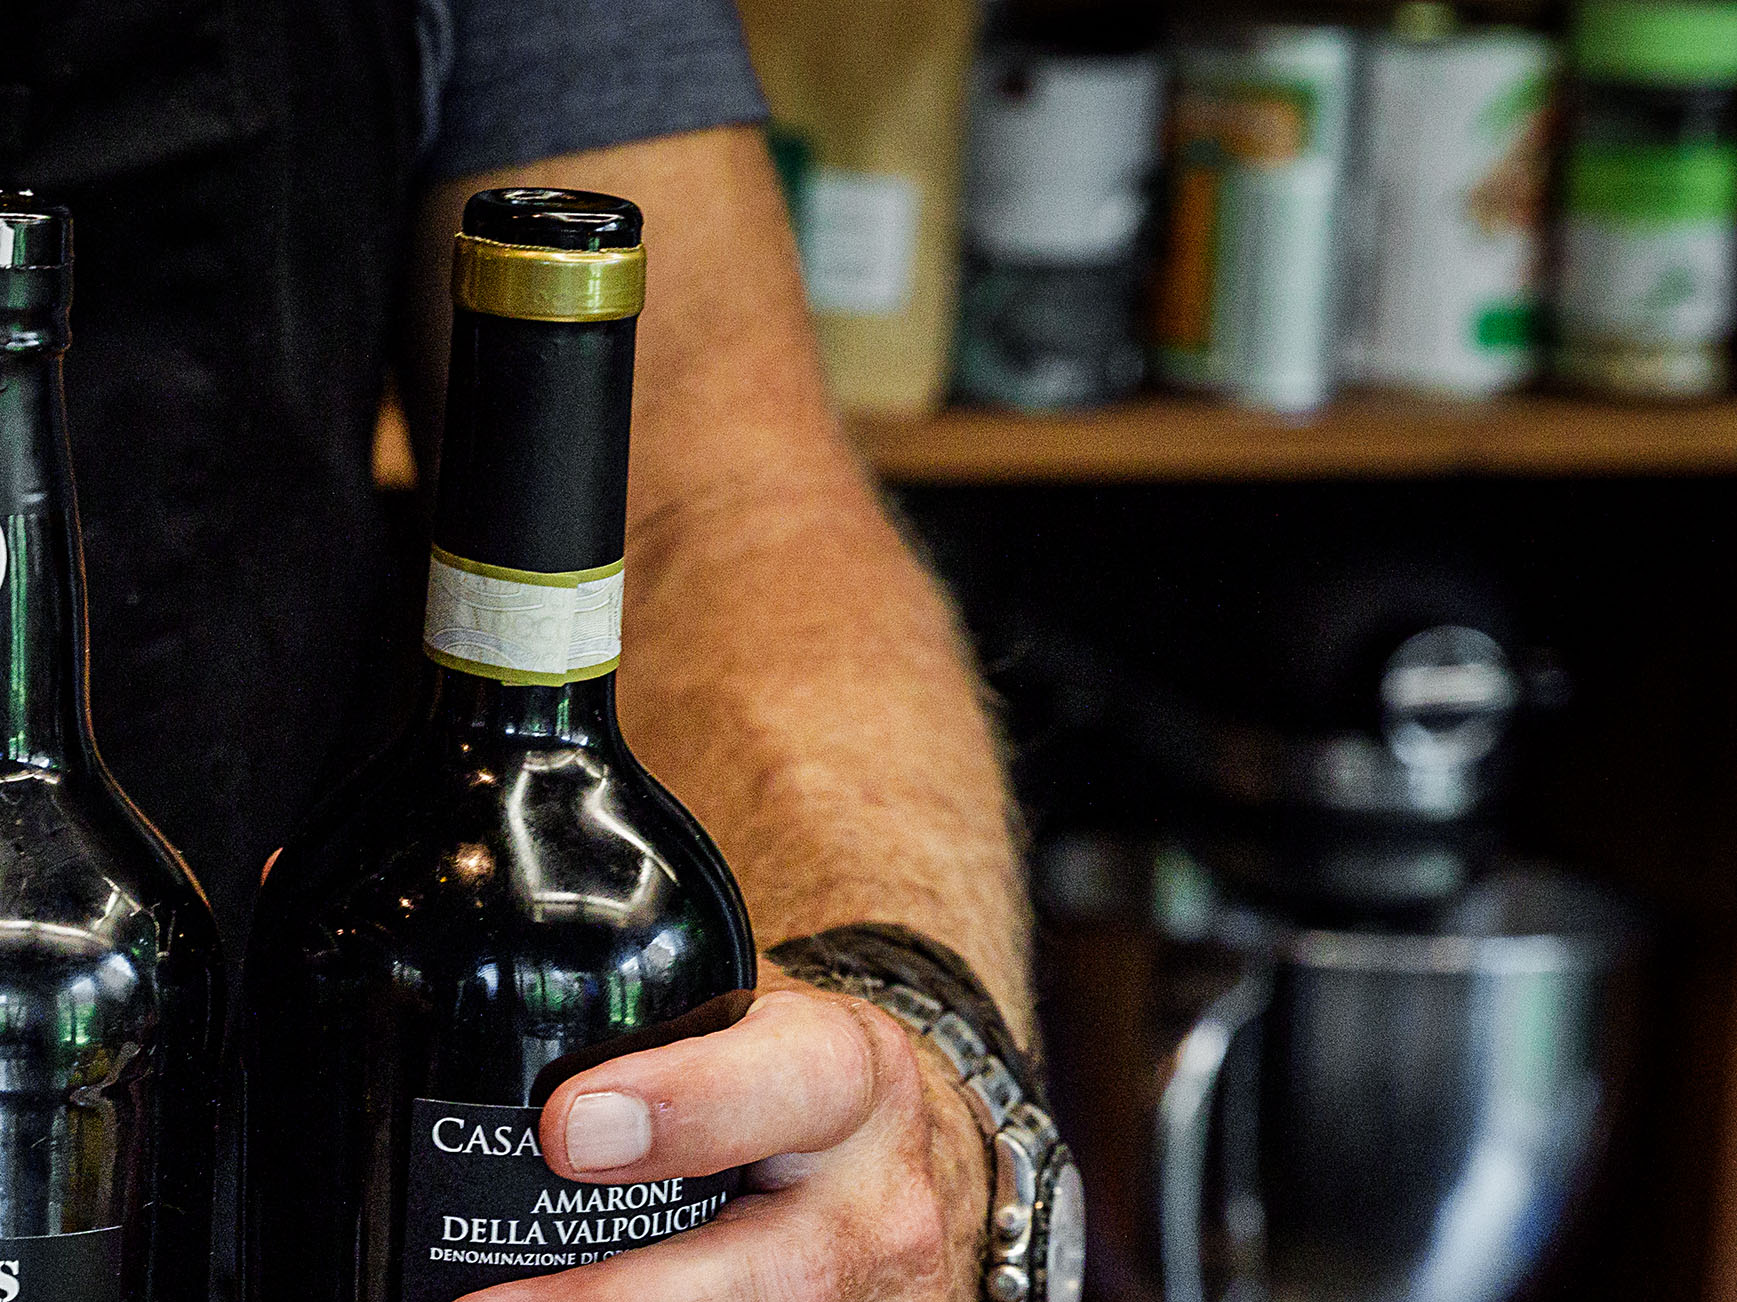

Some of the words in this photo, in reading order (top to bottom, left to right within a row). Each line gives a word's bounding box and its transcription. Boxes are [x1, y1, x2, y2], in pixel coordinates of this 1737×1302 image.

[531, 1177, 684, 1214] AMARONE
[442, 1215, 549, 1246] DELLA
[429, 1247, 576, 1267] DENOMINAZIONE
[580, 1251, 599, 1265] DI
